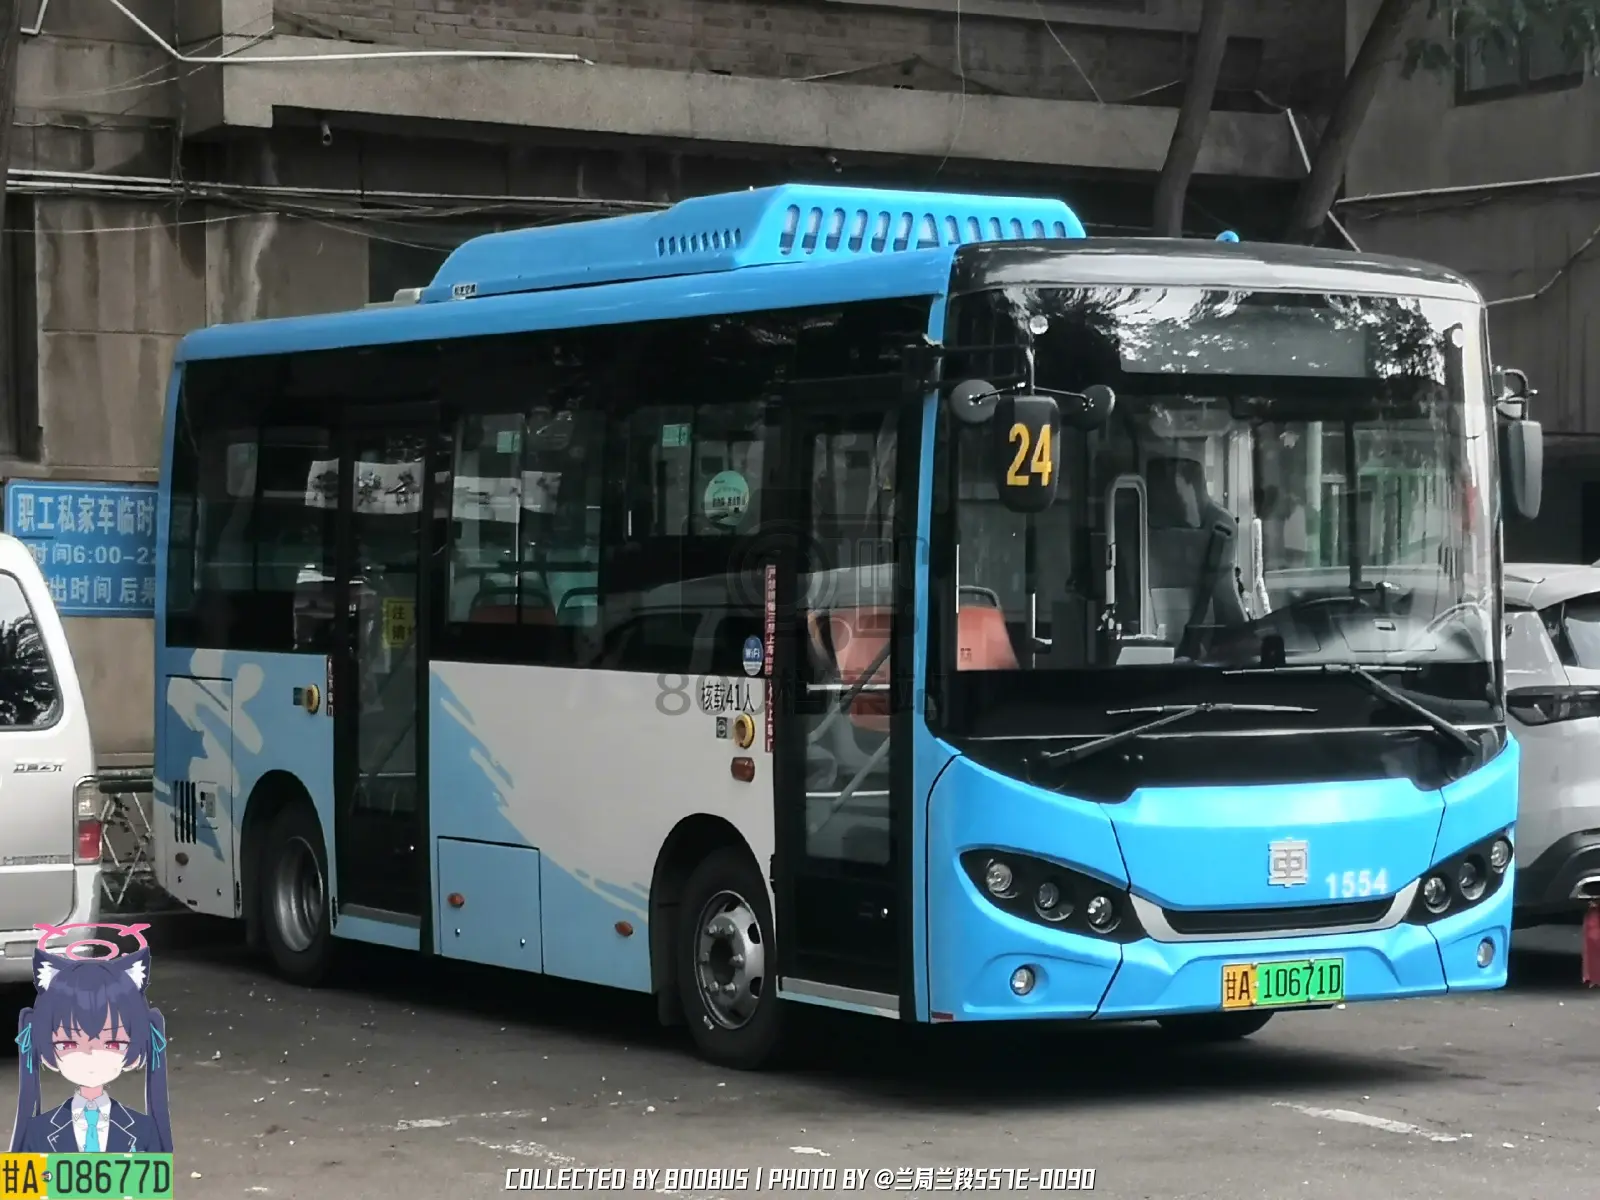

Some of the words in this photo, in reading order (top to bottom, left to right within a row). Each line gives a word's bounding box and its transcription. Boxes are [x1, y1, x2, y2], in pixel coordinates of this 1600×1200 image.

[1007, 423, 1052, 487] 24
[17, 493, 155, 537] 职工私家车临时
[701, 681, 755, 712] 核载41人
[1325, 867, 1389, 899] 1554
